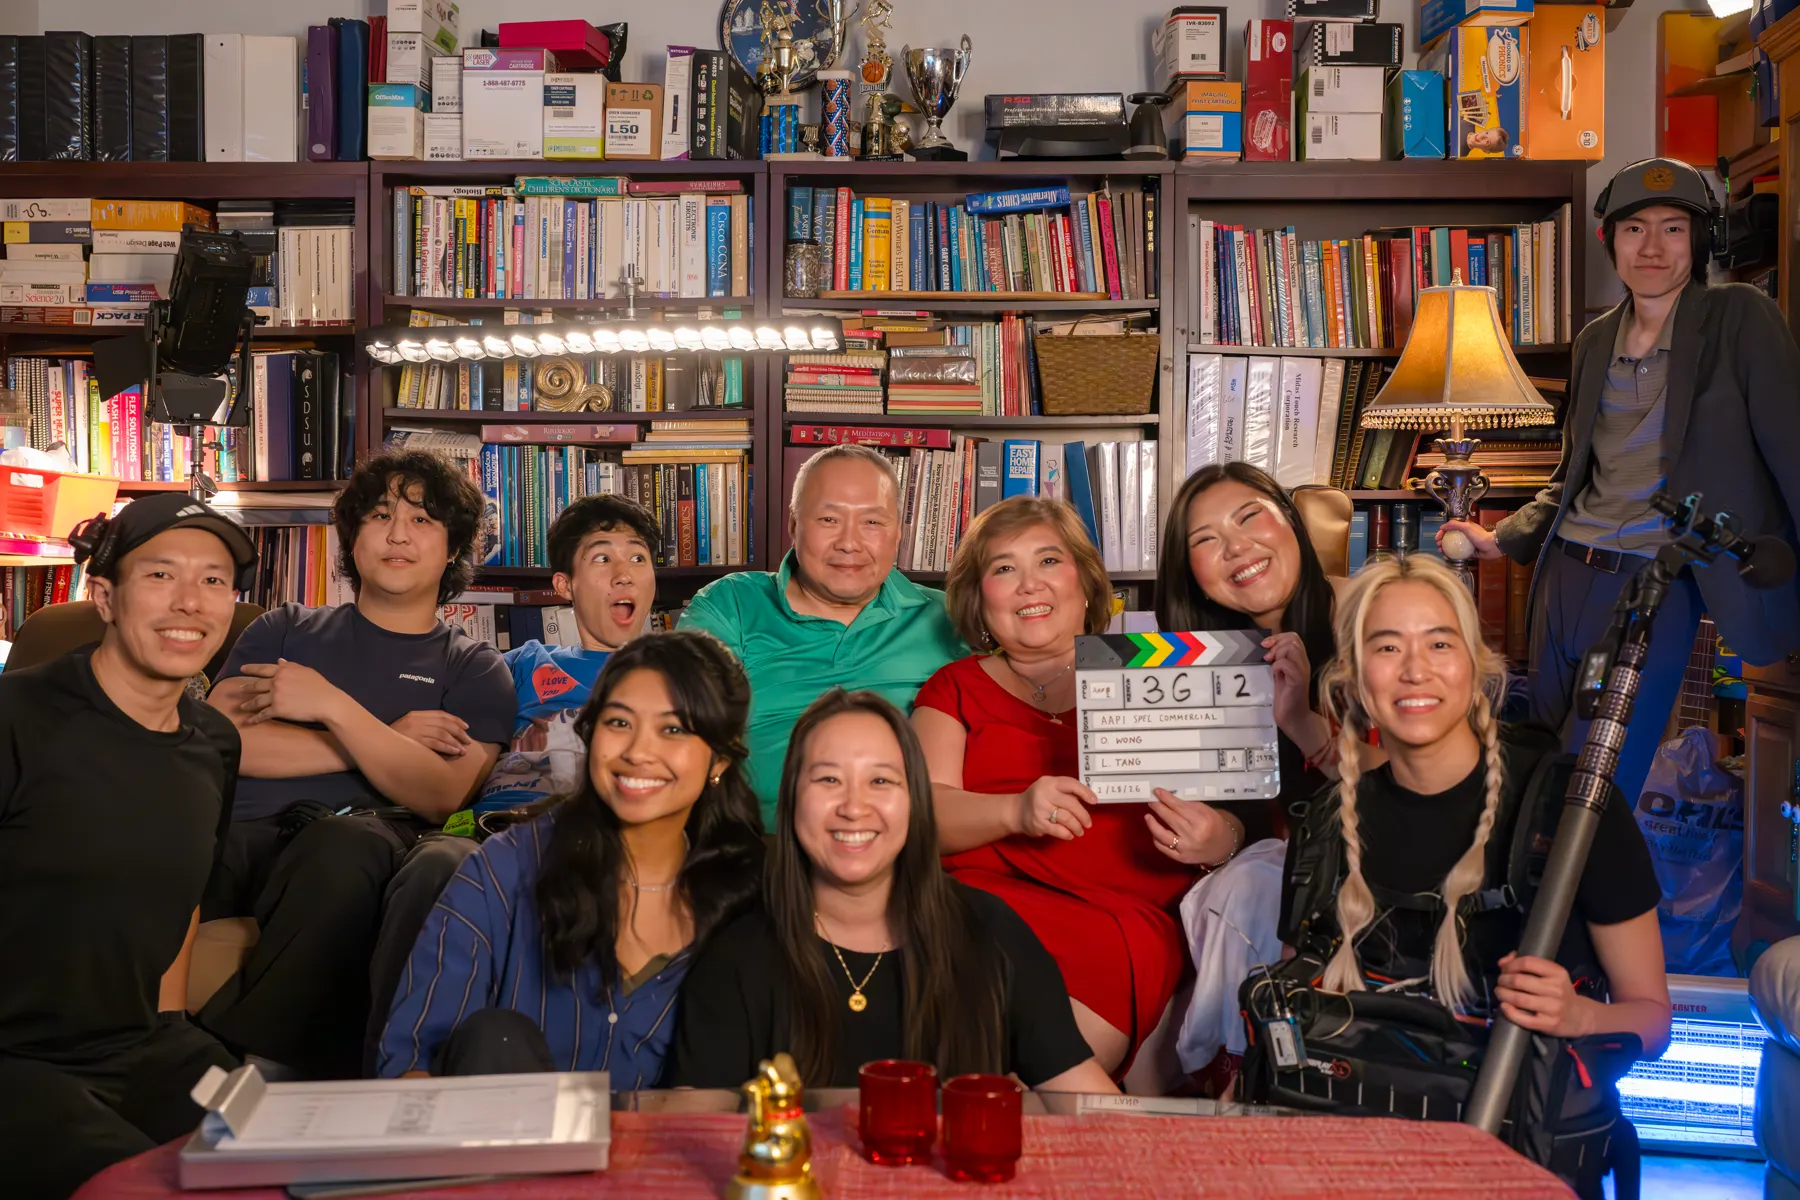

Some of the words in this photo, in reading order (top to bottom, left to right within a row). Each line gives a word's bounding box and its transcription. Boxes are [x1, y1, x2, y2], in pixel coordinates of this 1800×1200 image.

[1499, 45, 1507, 78] PHONICS
[1506, 64, 1512, 72] ON
[609, 124, 639, 134] L50
[549, 179, 594, 187] SCHOLASTIC
[569, 186, 616, 194] DICTIONARY
[997, 194, 1020, 207] CURES
[1021, 190, 1057, 203] Alternative
[565, 207, 573, 218] New
[421, 227, 430, 247] Dean
[565, 223, 573, 241] Primer
[822, 205, 835, 262] HISTORY
[892, 207, 904, 256] EveryWoman's
[126, 239, 147, 248] Design
[148, 239, 162, 248] Page
[163, 240, 176, 248] Web
[565, 242, 573, 254] Plus
[1236, 240, 1244, 260] Basic
[434, 248, 442, 266] Totally
[718, 245, 728, 280] CCNA
[941, 247, 949, 262] GARY
[421, 249, 430, 281] Graziosi
[895, 257, 903, 291] HEALTH
[942, 264, 950, 291] COCHRAN
[1237, 261, 1246, 293] Sciences
[26, 292, 53, 304] Science
[1522, 275, 1530, 310] NUTRITIONAL
[96, 312, 126, 320] PACK
[519, 363, 527, 388] dows
[633, 361, 642, 390] JavaScript
[649, 363, 657, 380] quality
[459, 372, 468, 393] yoga
[519, 388, 527, 399] 95
[54, 391, 62, 416] SUPER
[1284, 389, 1292, 431] Corporation
[129, 416, 137, 462] SOLUTIONS
[1292, 418, 1300, 448] Research
[1010, 449, 1034, 458] EASY
[1010, 458, 1035, 466] HOME
[485, 451, 493, 492] encyclopedia
[1010, 466, 1034, 474] REPAIR
[933, 483, 941, 503] Design
[951, 481, 959, 508] COMPUTER
[681, 506, 692, 561] ECONOMICS
[399, 672, 435, 684] patagonia
[546, 676, 568, 686] LOVE
[1234, 673, 1251, 698] 2
[1101, 714, 1126, 725] AAPI
[1133, 714, 1152, 723] SPEC
[1159, 713, 1218, 722] COMMERCIAL
[1100, 737, 1110, 745] O.
[1116, 736, 1143, 744] WONG
[1101, 758, 1111, 768] L.
[1116, 758, 1141, 766] TANG
[1231, 755, 1237, 763] A
